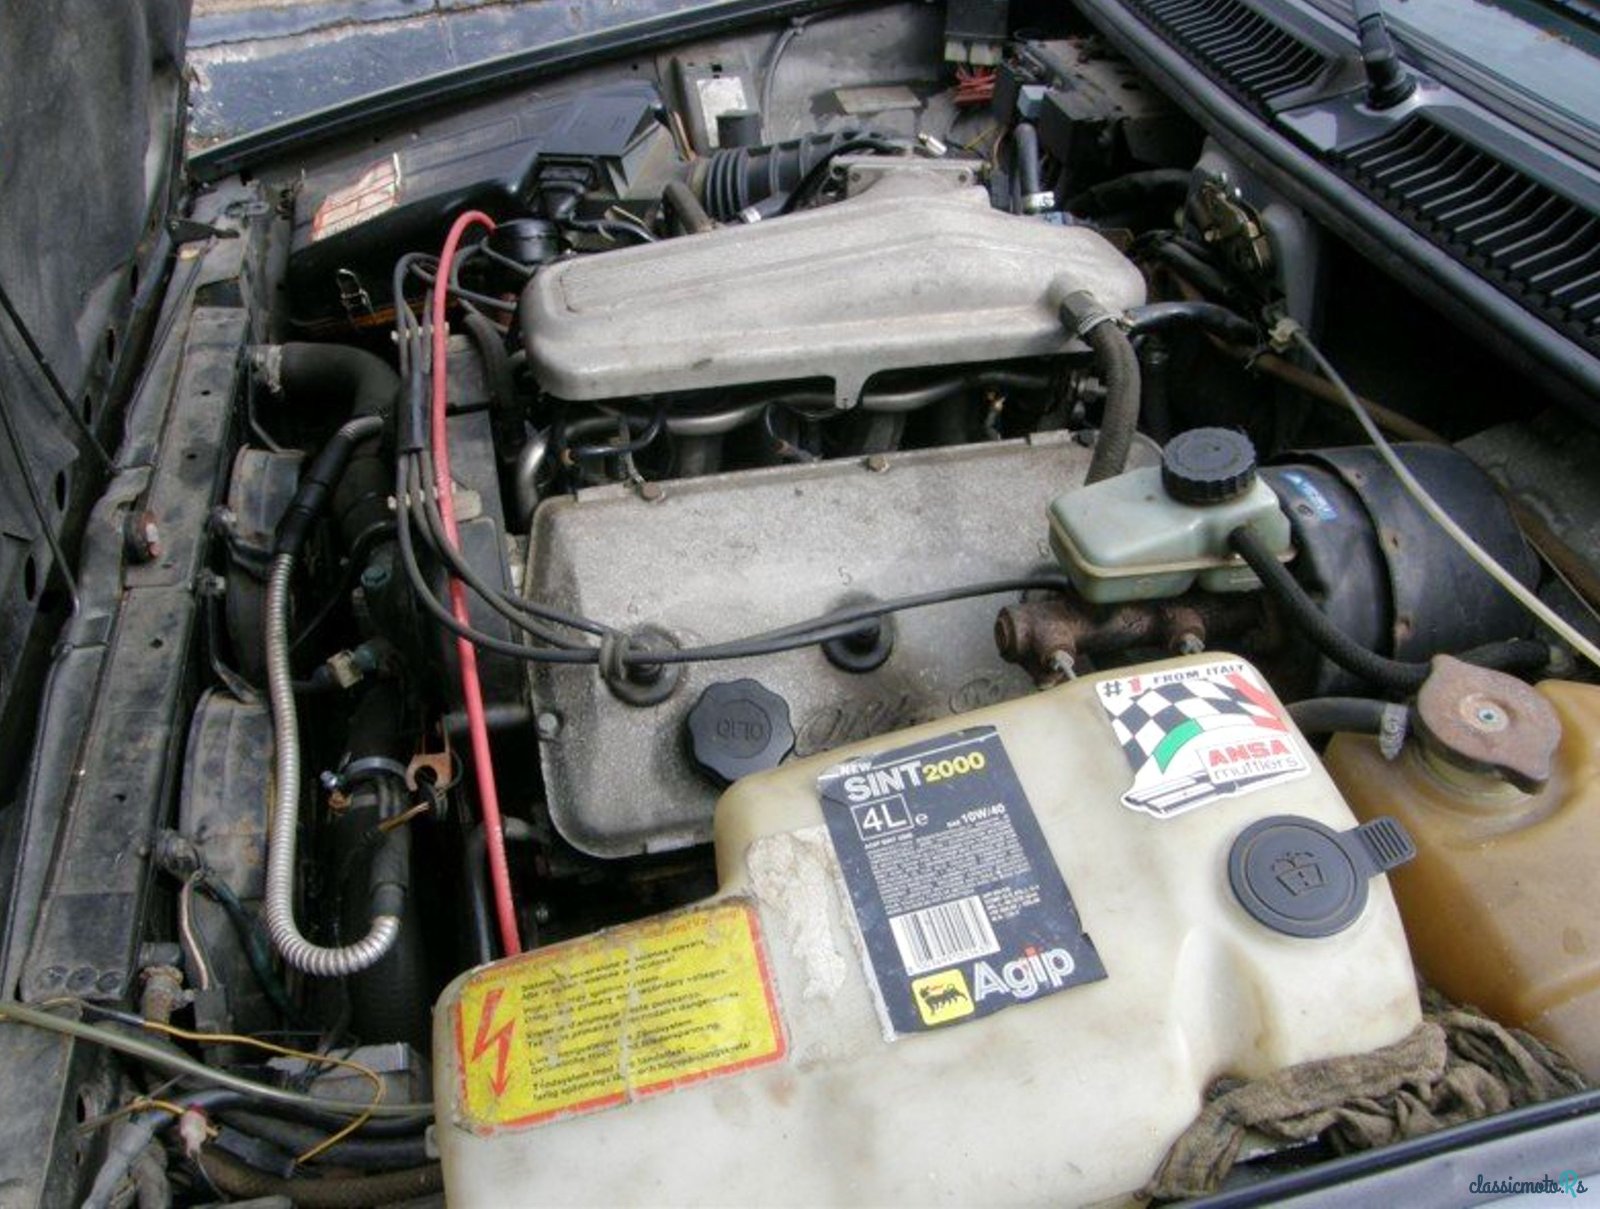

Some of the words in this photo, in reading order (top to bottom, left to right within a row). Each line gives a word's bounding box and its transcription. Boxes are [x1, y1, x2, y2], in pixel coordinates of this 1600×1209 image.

[838, 565, 853, 586] 5
[1153, 670, 1200, 685] FROM
[1206, 663, 1244, 678] ITALY
[716, 717, 763, 742] OLIO
[1208, 739, 1291, 768] ANSA
[1214, 756, 1299, 781] mufflers
[863, 803, 907, 831] 4L
[973, 945, 1074, 1001] Agip
